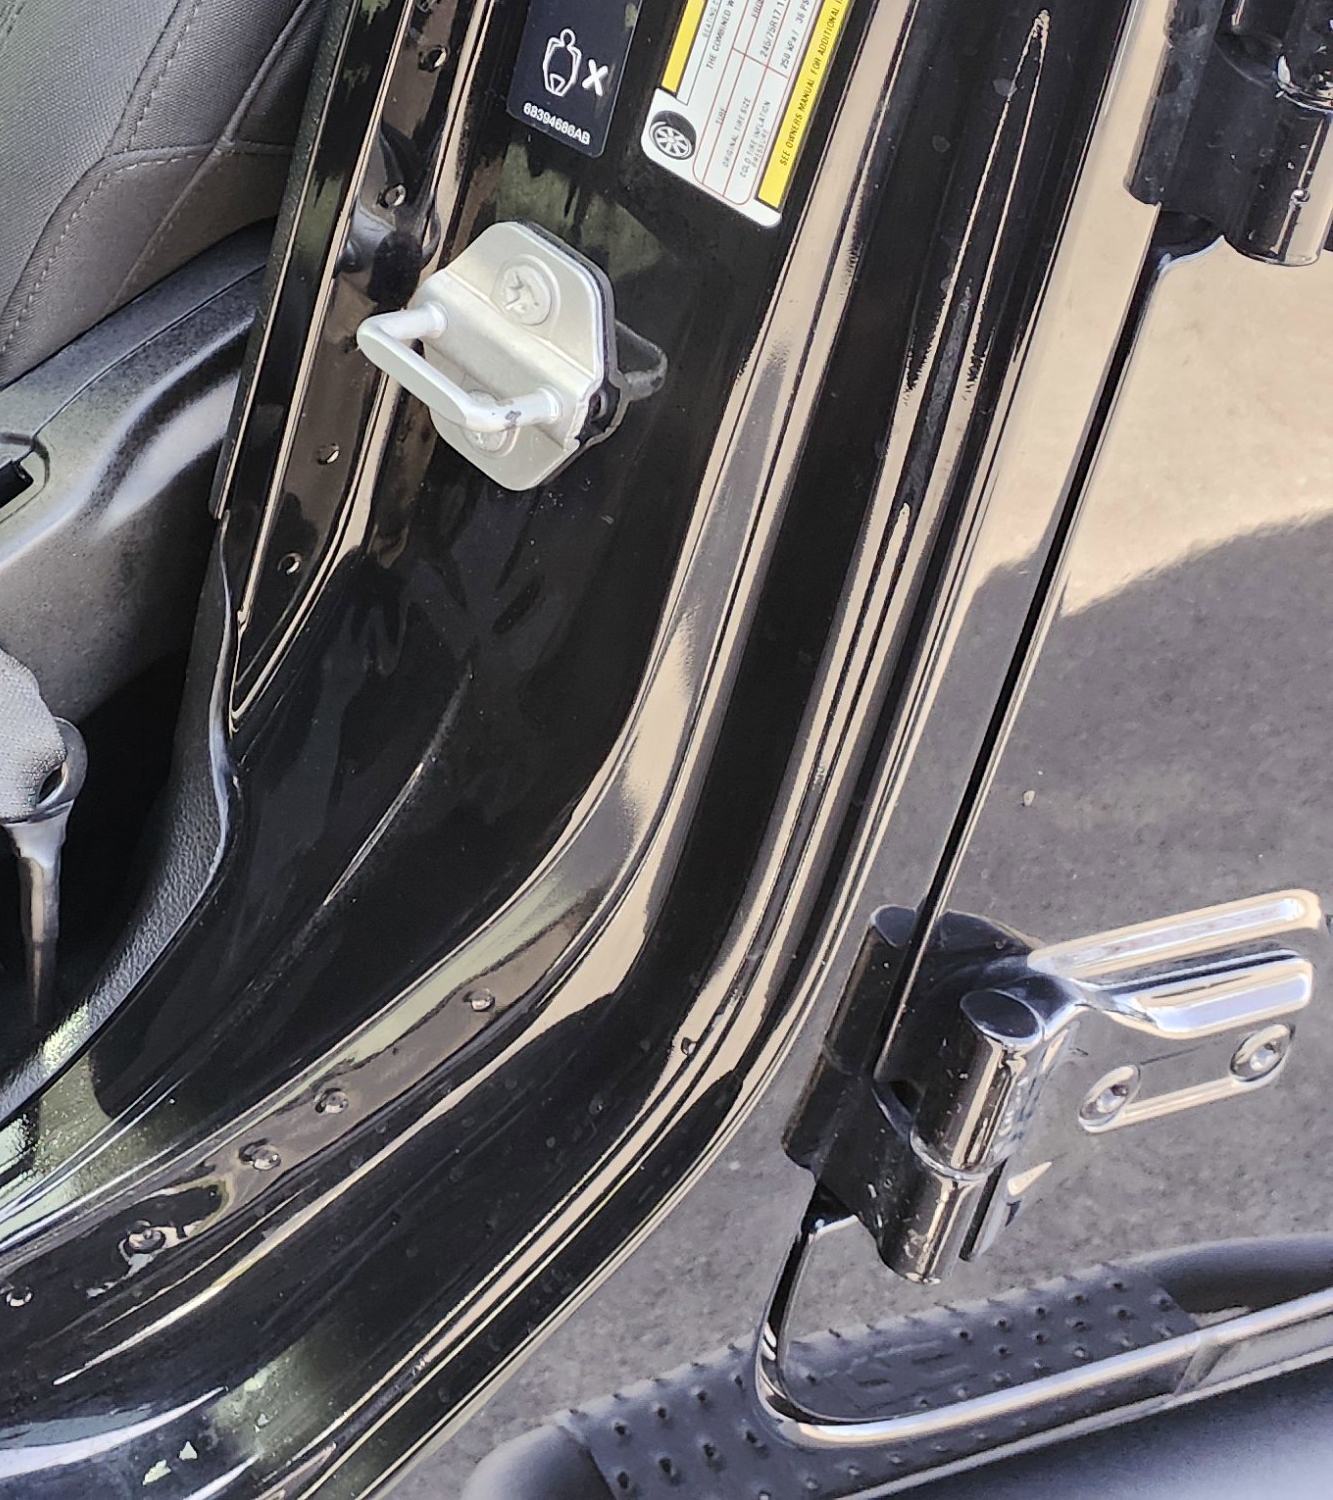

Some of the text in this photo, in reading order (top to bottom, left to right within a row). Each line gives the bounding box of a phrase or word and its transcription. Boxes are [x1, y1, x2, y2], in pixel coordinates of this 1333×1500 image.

[705, 53, 717, 70] THE
[711, 9, 731, 52] COMBINED
[759, 8, 782, 58] 245/75R17
[779, 149, 791, 166] SEE
[785, 113, 803, 149] OWNERS
[797, 79, 815, 112] MANUAL
[809, 57, 822, 76] FOR
[817, 7, 840, 56] ADDITIONAL
[714, 106, 728, 127] TIRE
